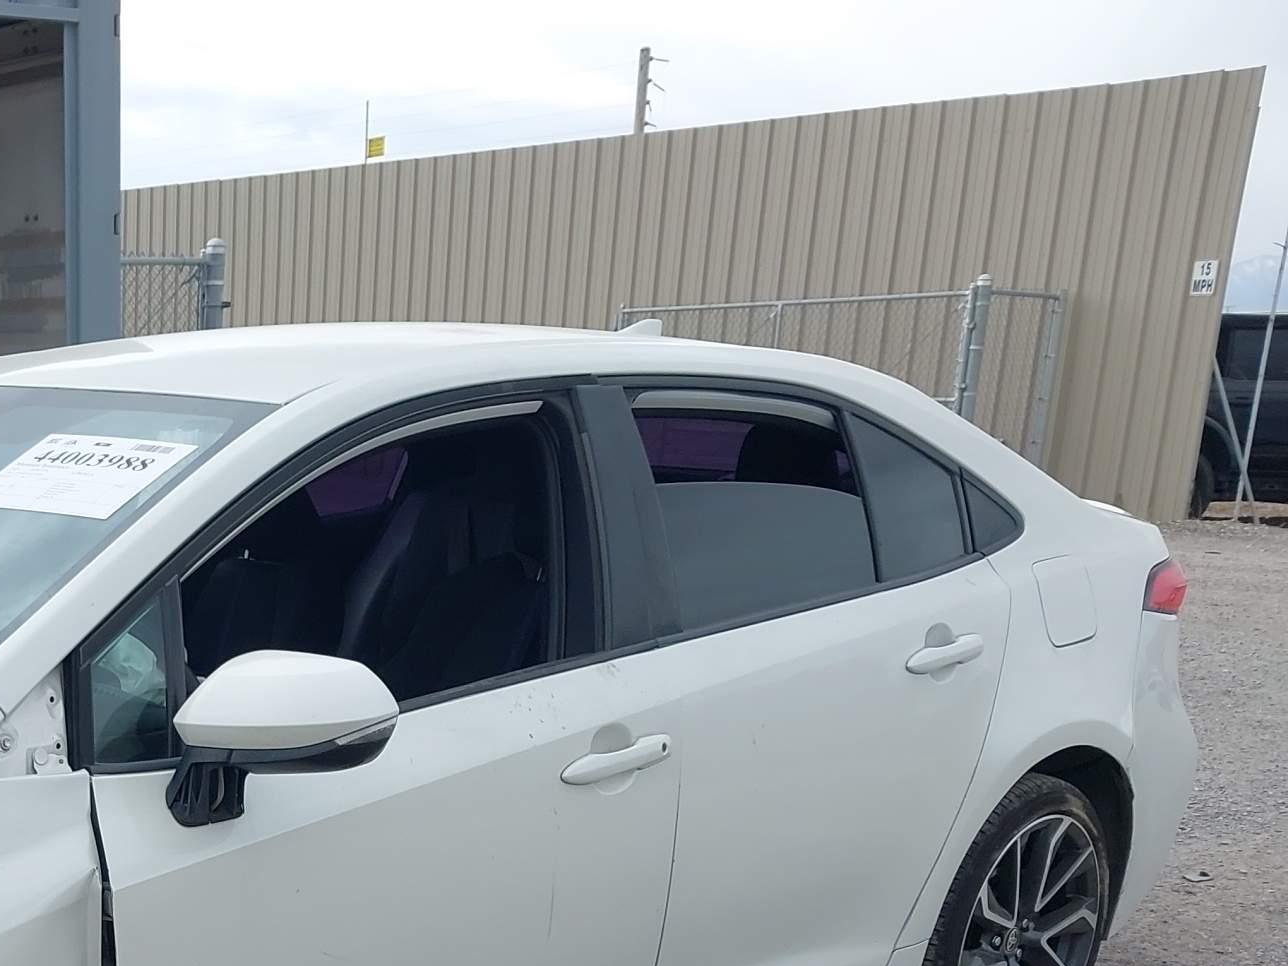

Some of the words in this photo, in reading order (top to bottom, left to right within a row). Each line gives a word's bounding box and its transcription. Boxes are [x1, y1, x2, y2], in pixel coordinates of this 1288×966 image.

[1200, 263, 1212, 276] 15
[1192, 279, 1214, 293] MPH
[33, 450, 156, 472] 44003988
